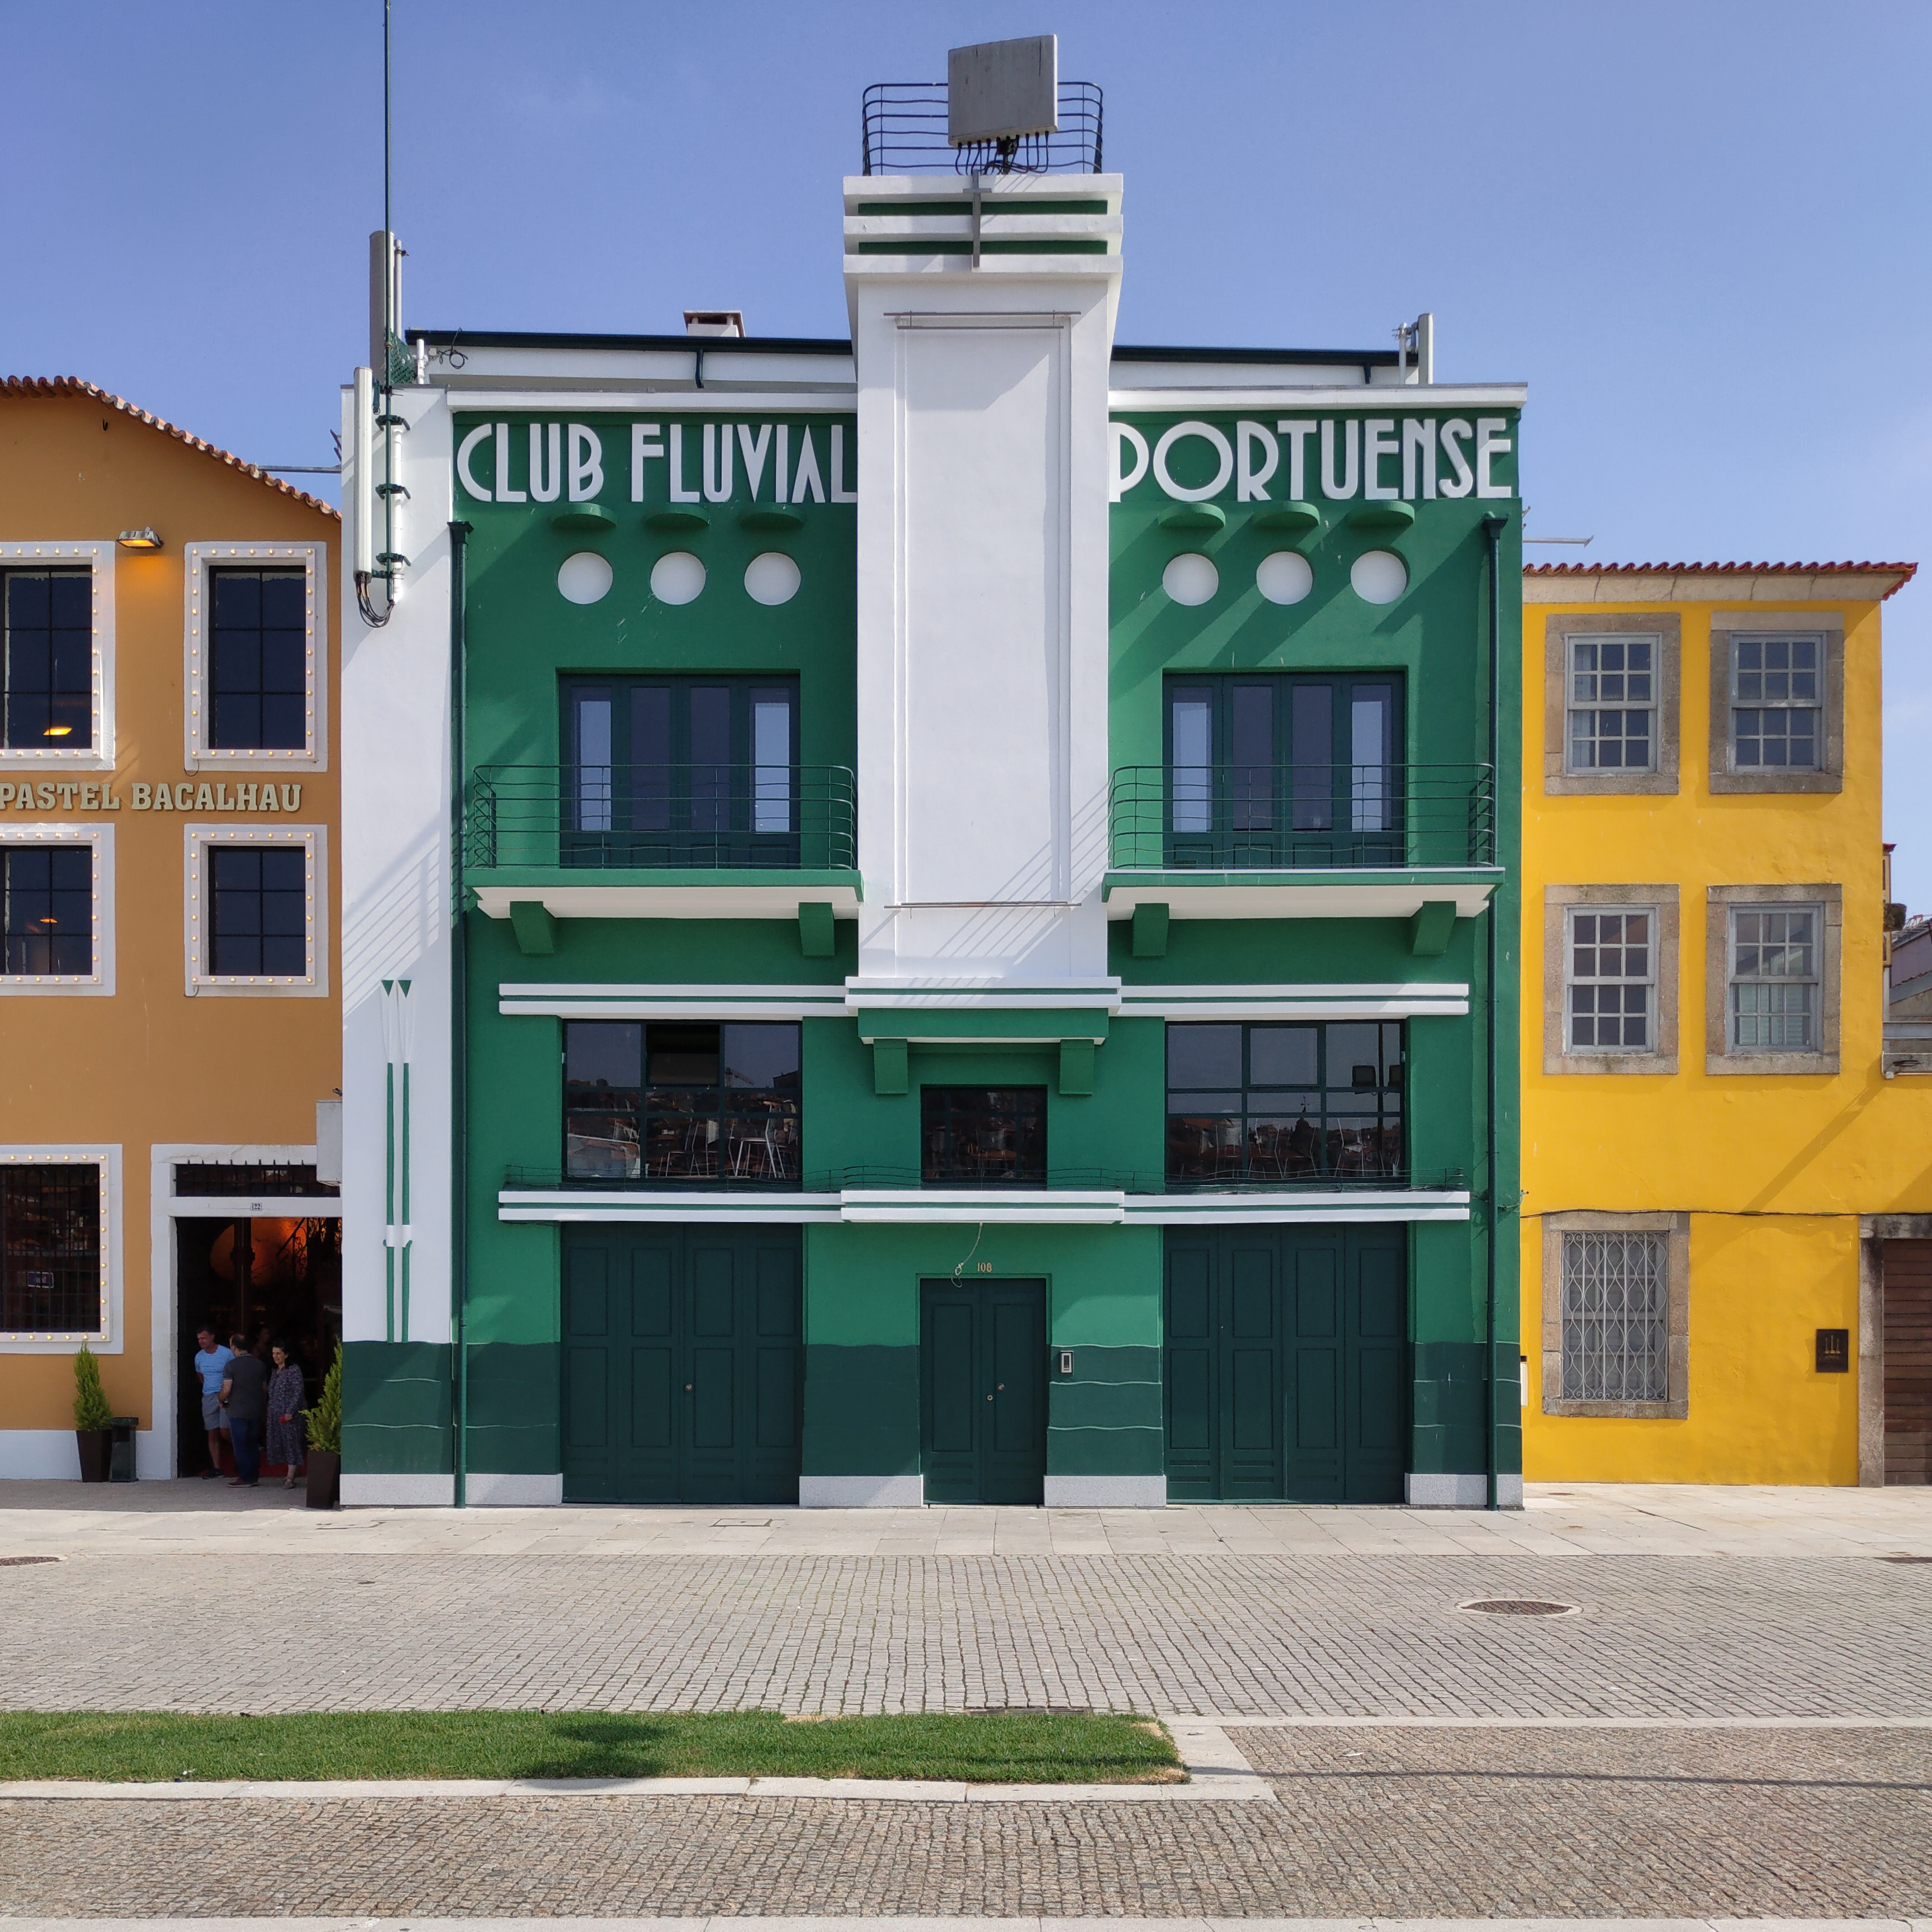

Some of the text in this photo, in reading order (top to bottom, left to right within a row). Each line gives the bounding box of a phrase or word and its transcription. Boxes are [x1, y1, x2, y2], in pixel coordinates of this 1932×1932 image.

[457, 418, 1512, 503] CLUB FLUVIAL PORTUENSE
[0, 782, 301, 812] PASTEL BACALHAU
[977, 1262, 992, 1272] 108
